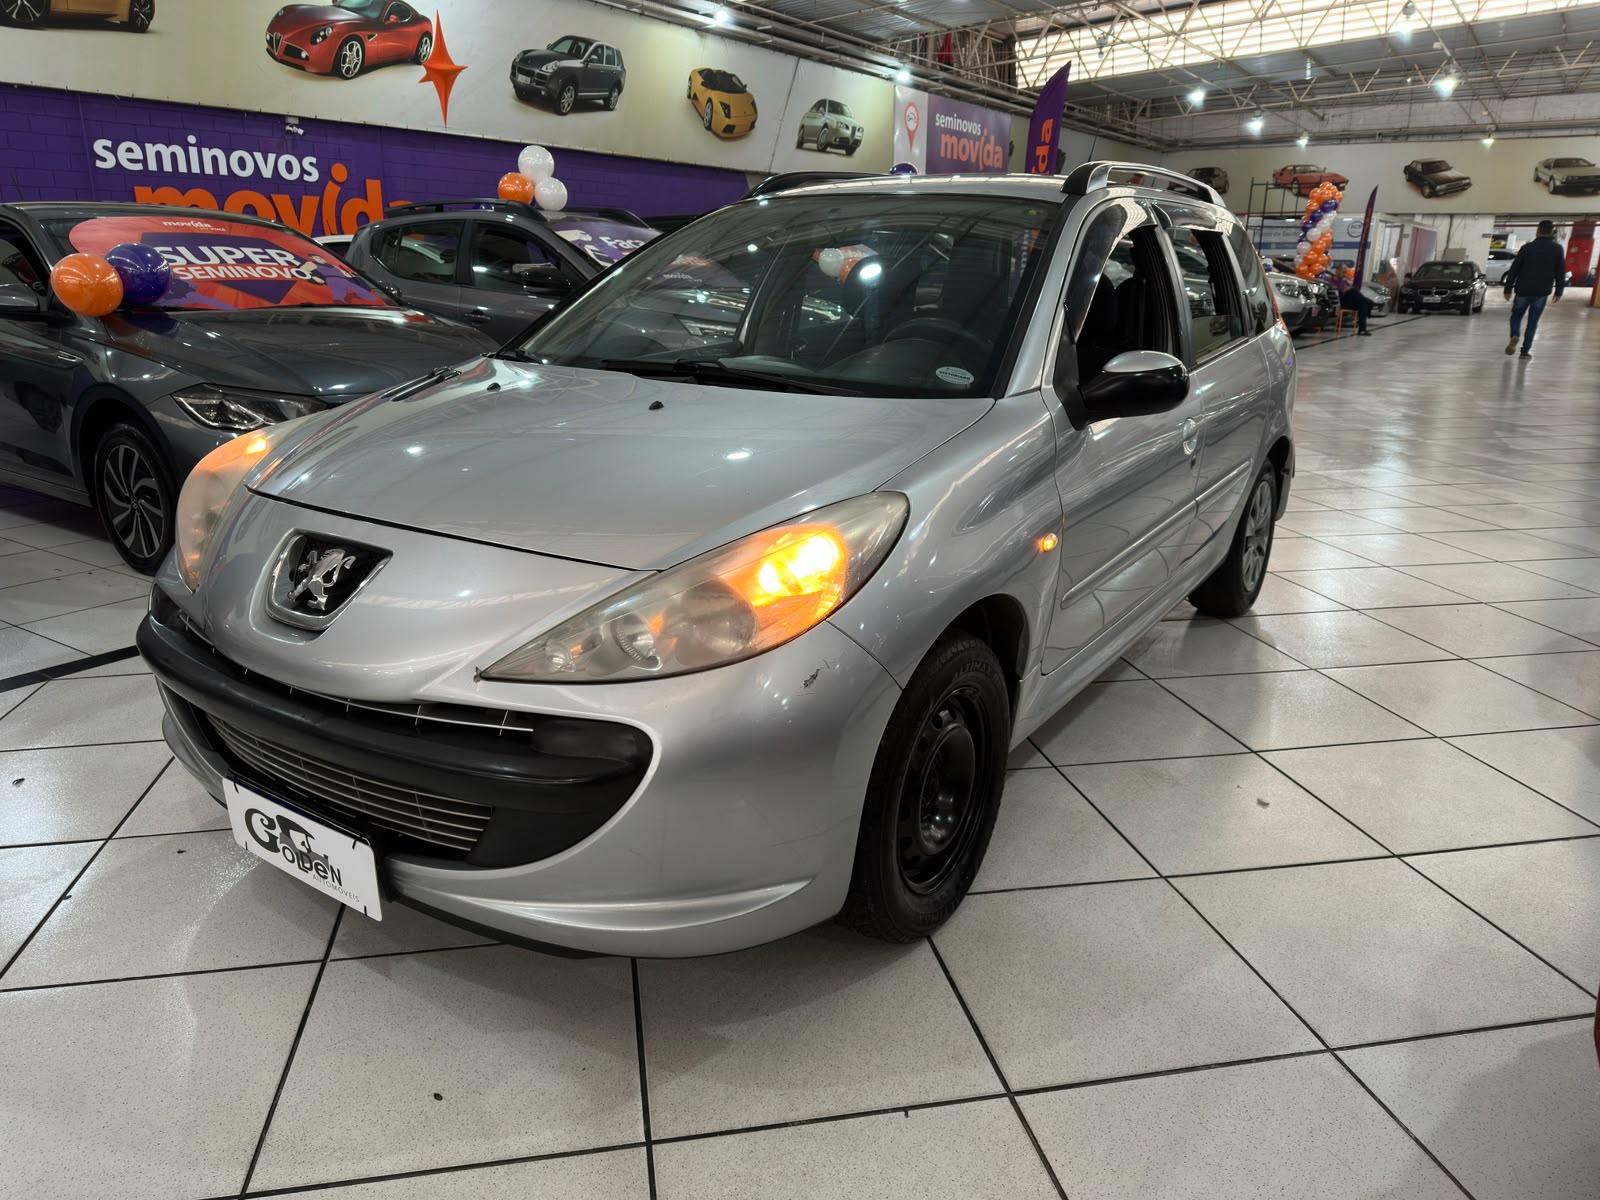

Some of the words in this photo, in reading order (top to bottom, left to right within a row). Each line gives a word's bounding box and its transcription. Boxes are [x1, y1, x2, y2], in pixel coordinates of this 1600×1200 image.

[936, 112, 982, 136] seminovos
[92, 134, 320, 183] seminovos
[940, 127, 1004, 171] movida
[153, 245, 301, 267] SUPER
[172, 265, 312, 281] SEMINOVO
